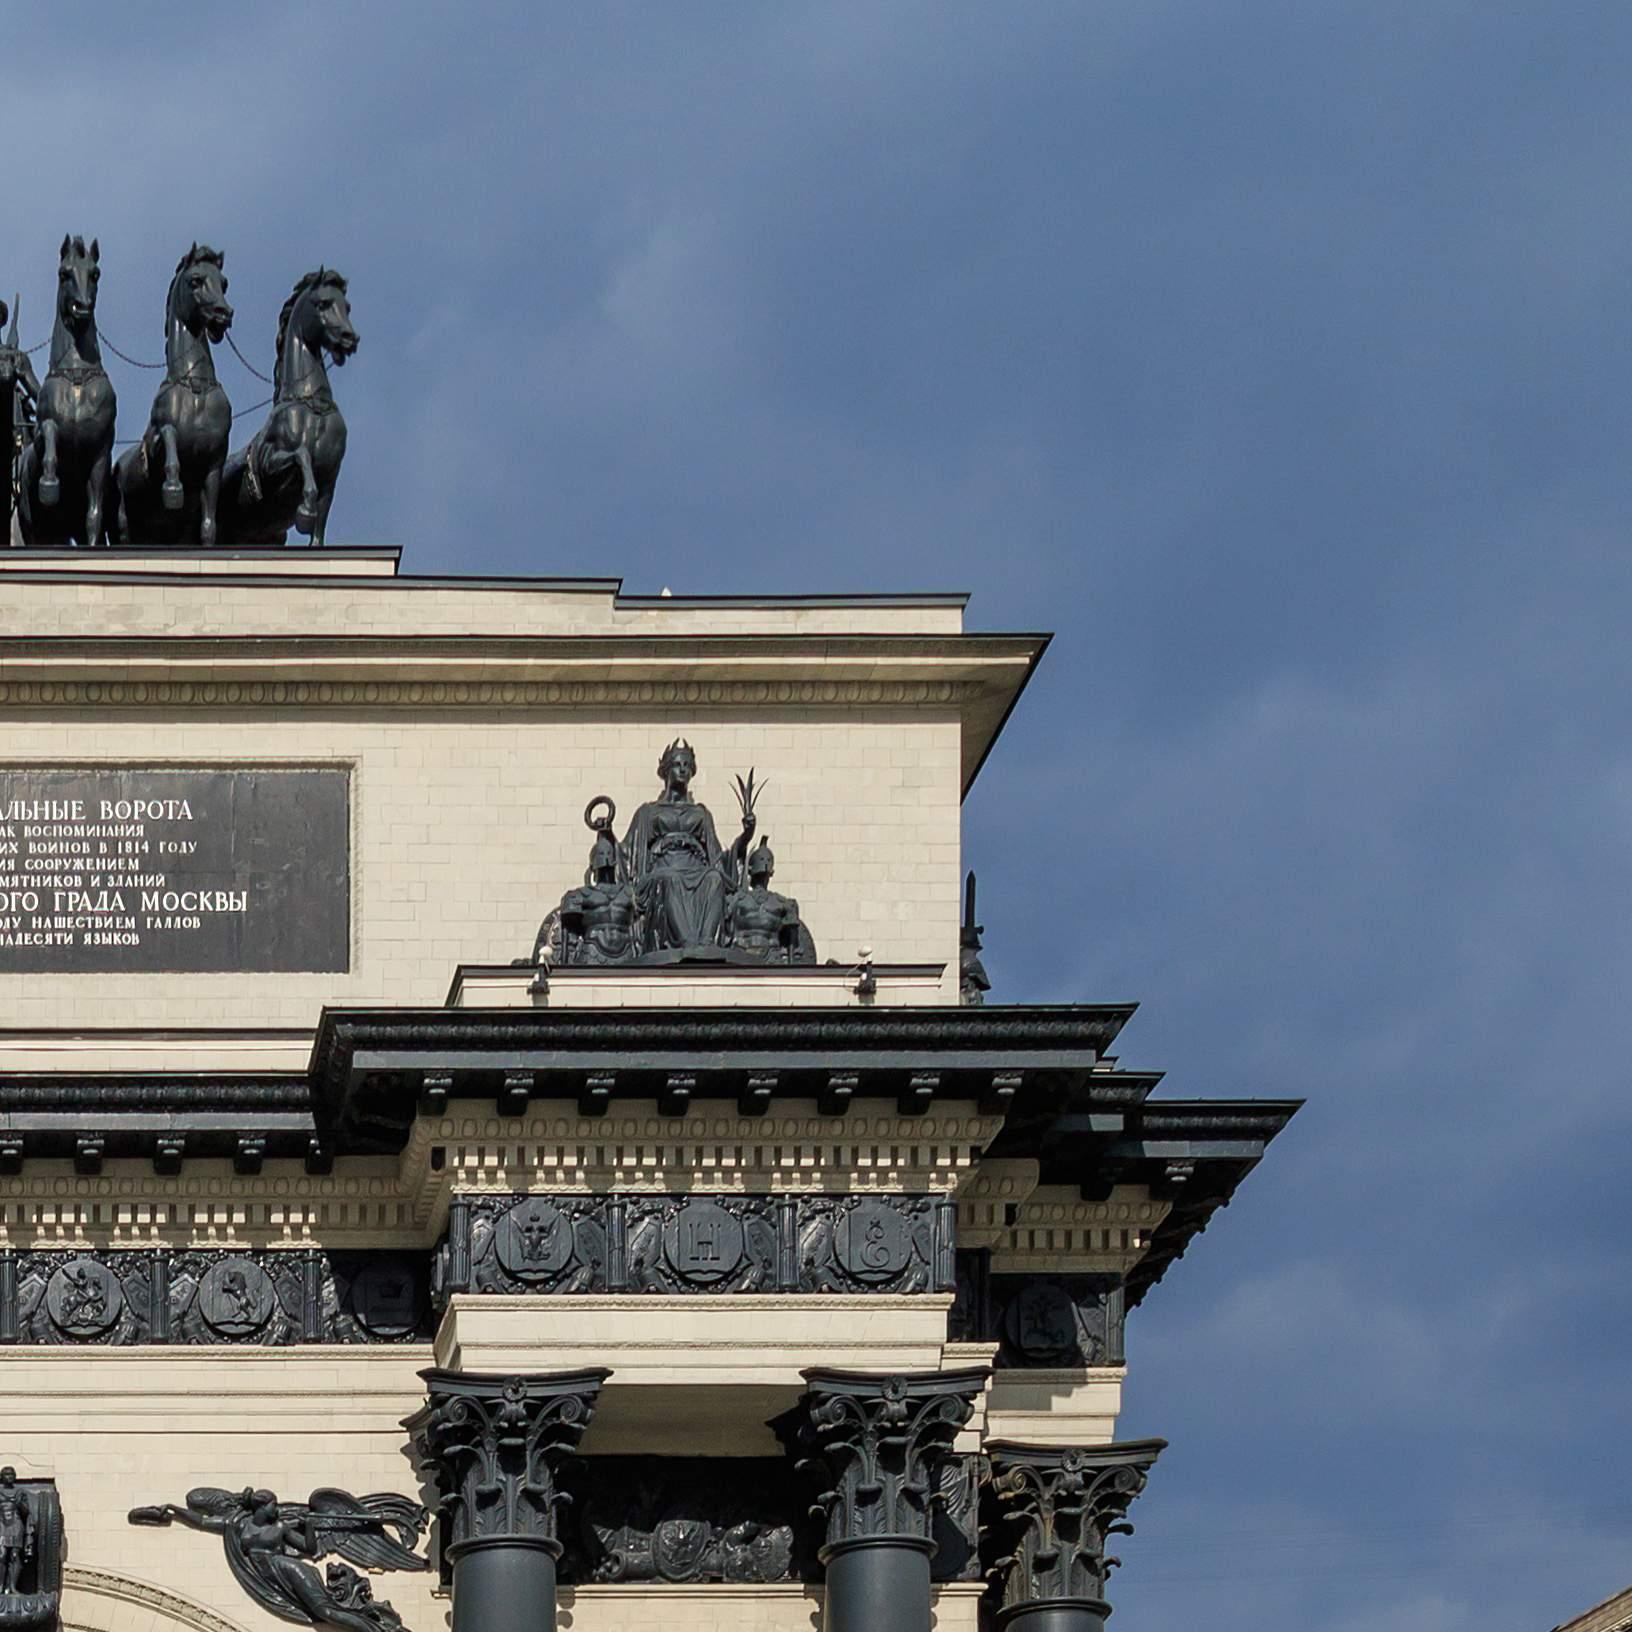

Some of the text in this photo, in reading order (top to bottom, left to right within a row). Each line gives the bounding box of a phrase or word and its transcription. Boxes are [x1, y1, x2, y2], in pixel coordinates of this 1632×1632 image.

[100, 799, 193, 820] ВОРОТА
[23, 824, 144, 837] ВОСПОМИНАНИЯ
[28, 841, 91, 854] ВОИНОВ
[99, 841, 108, 854] В
[116, 841, 149, 854] 1814
[159, 841, 197, 854] ГОДУ
[24, 857, 140, 870] СООРУЖЕНИЕМ
[90, 874, 101, 887] И
[107, 873, 165, 887] ЗДАНИЙ
[53, 890, 126, 912] ГРАДА
[140, 890, 248, 912] МОСКВЫ
[31, 916, 136, 929] НАШЕСТВИЕМ
[146, 916, 201, 929] ГАЛЛОВ
[83, 933, 140, 946] ЯЗЫКОВ
